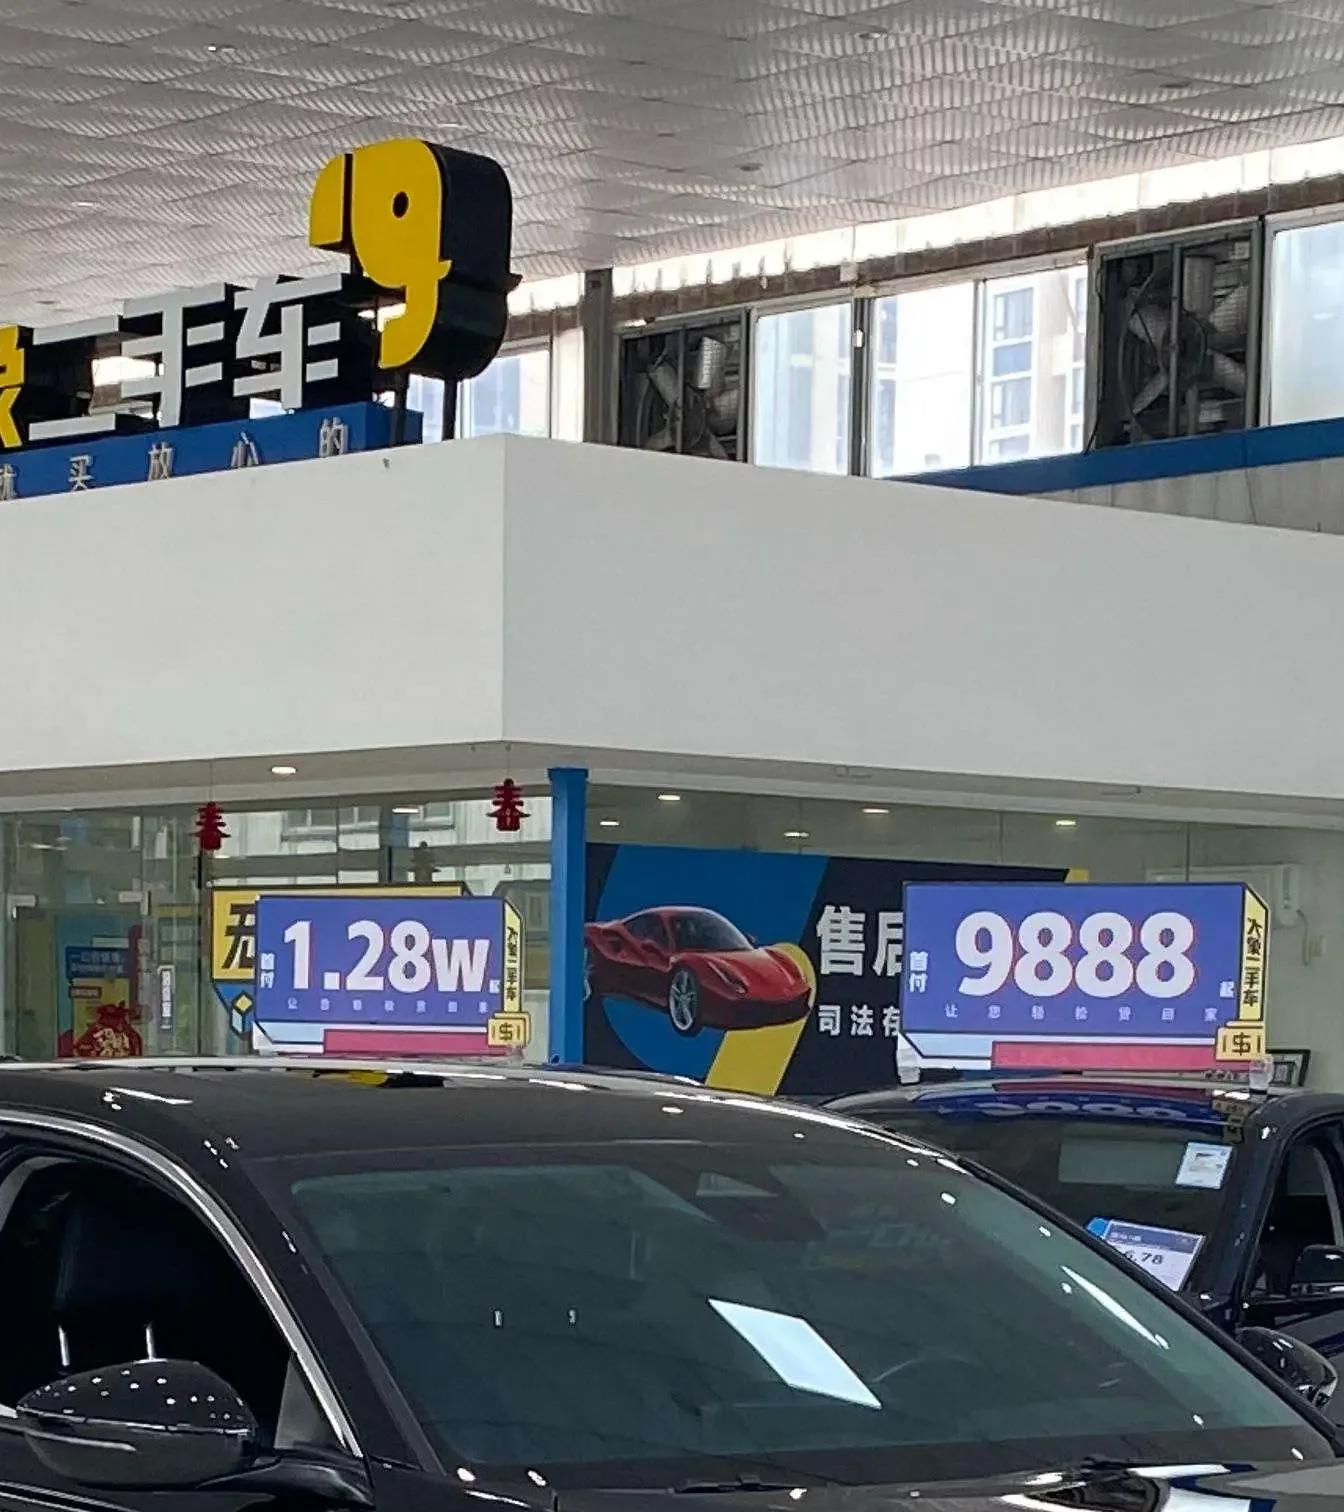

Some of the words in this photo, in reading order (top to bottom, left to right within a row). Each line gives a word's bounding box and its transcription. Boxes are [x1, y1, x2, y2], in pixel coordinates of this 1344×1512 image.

[909, 951, 928, 993] 首付
[955, 911, 1195, 998] 9888
[1242, 918, 1262, 1007] 大象二手车
